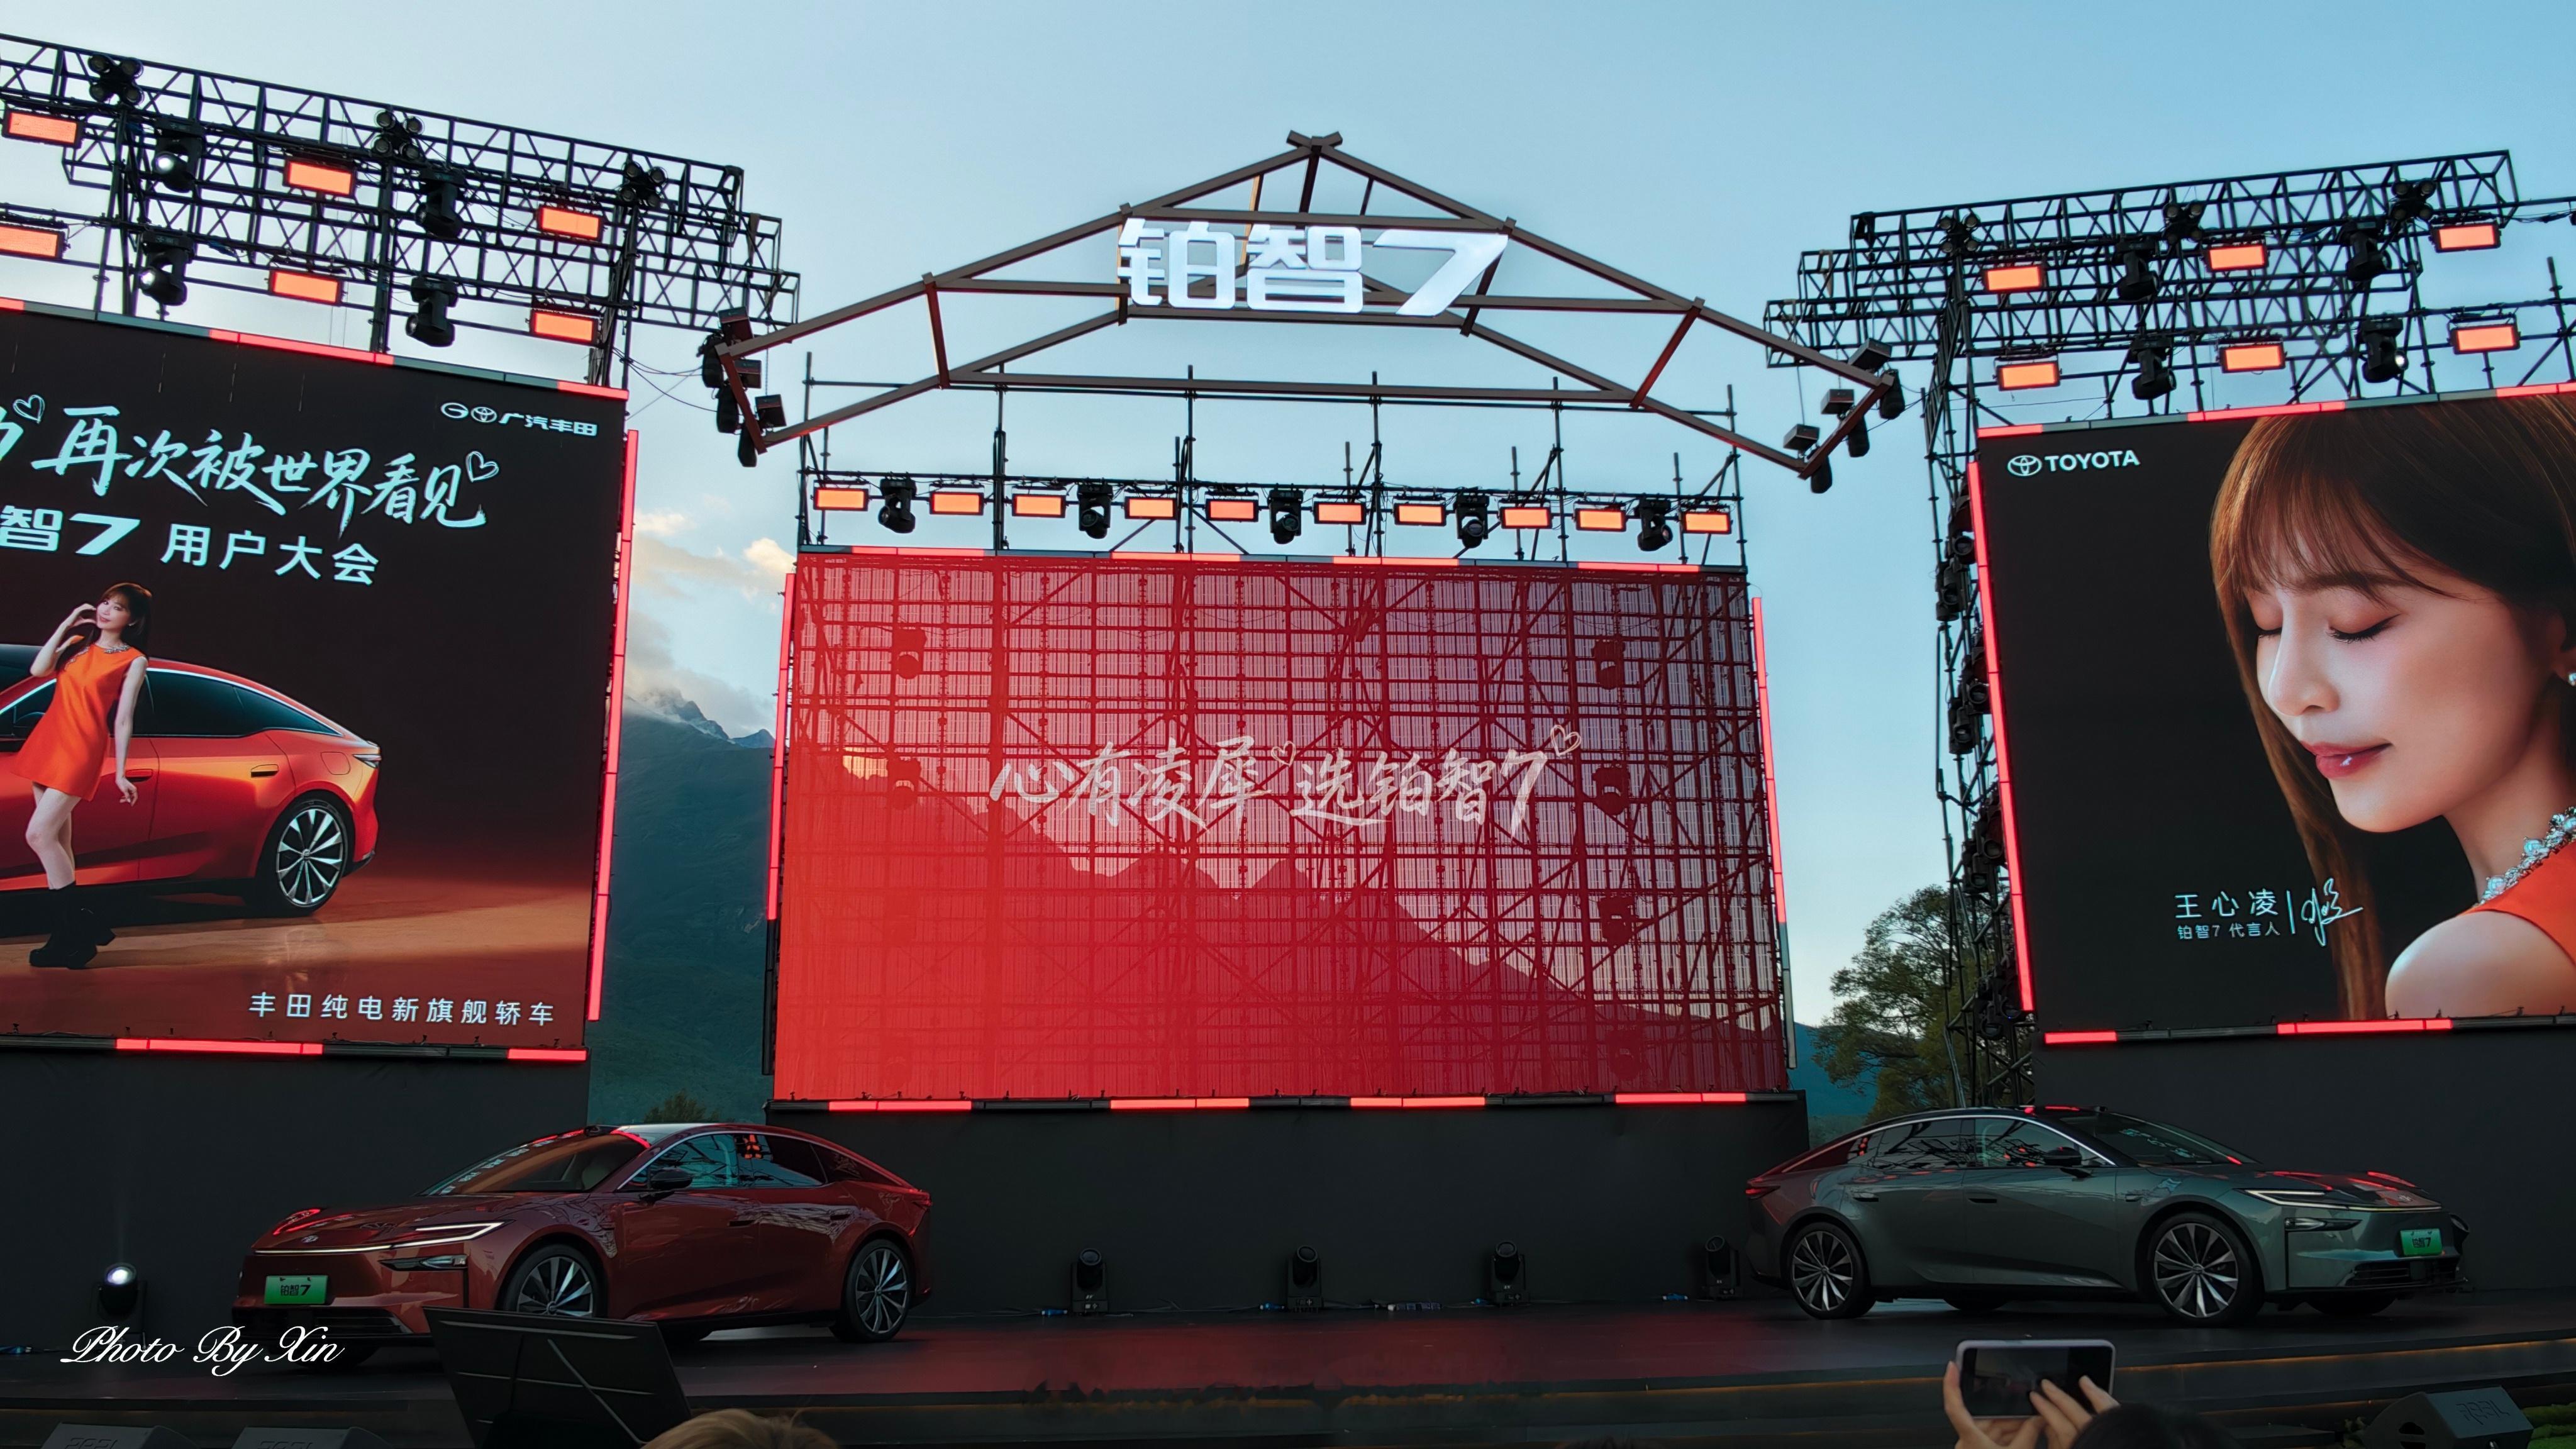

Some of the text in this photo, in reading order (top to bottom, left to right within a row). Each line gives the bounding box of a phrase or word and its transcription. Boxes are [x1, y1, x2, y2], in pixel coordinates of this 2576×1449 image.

[1117, 218, 1508, 317] 铂智7
[498, 413, 597, 436] 广汽丰田
[31, 406, 487, 539] 再次被世界看见
[2044, 450, 2140, 472] TOYOTA
[160, 523, 379, 586] 用户大会
[2174, 888, 2279, 918] 王心凌
[2229, 921, 2280, 938] 代言人
[248, 991, 553, 1026] 丰田纯电新旗舰轿车
